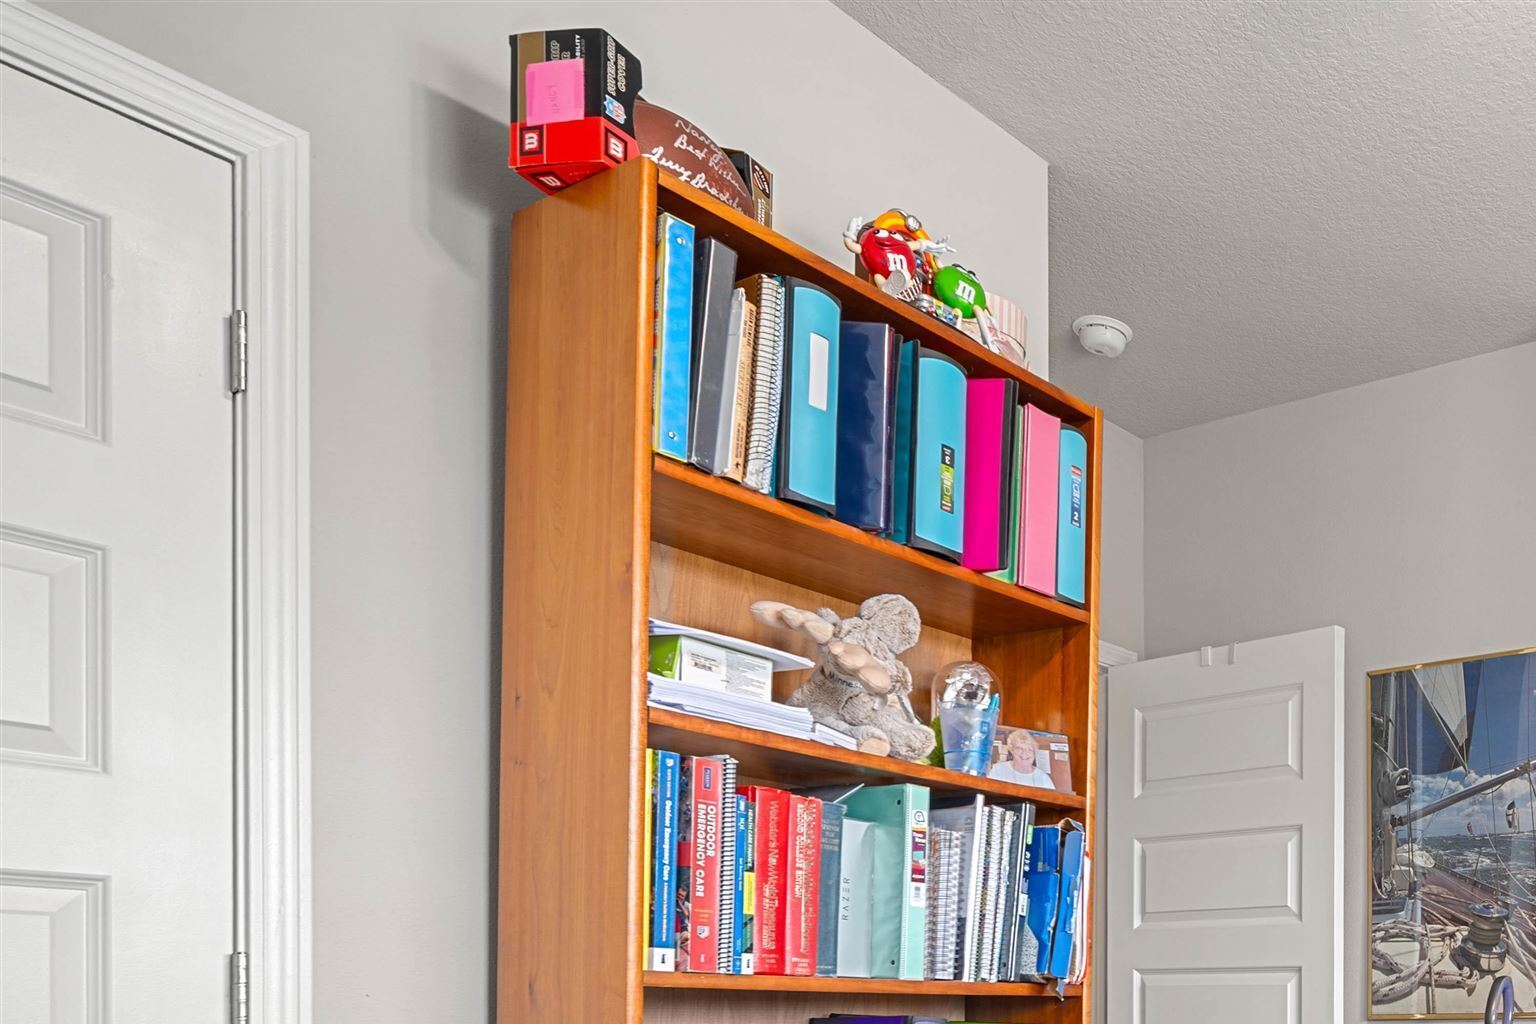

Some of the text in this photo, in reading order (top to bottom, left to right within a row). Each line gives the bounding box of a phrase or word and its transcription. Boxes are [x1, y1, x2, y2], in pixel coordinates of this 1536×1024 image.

[665, 800, 673, 828] Outdoor
[706, 805, 717, 857] OUTDOOR
[662, 828, 671, 864] Emergency
[695, 803, 707, 898] EMERGENCY CARE
[662, 865, 670, 882] Care
